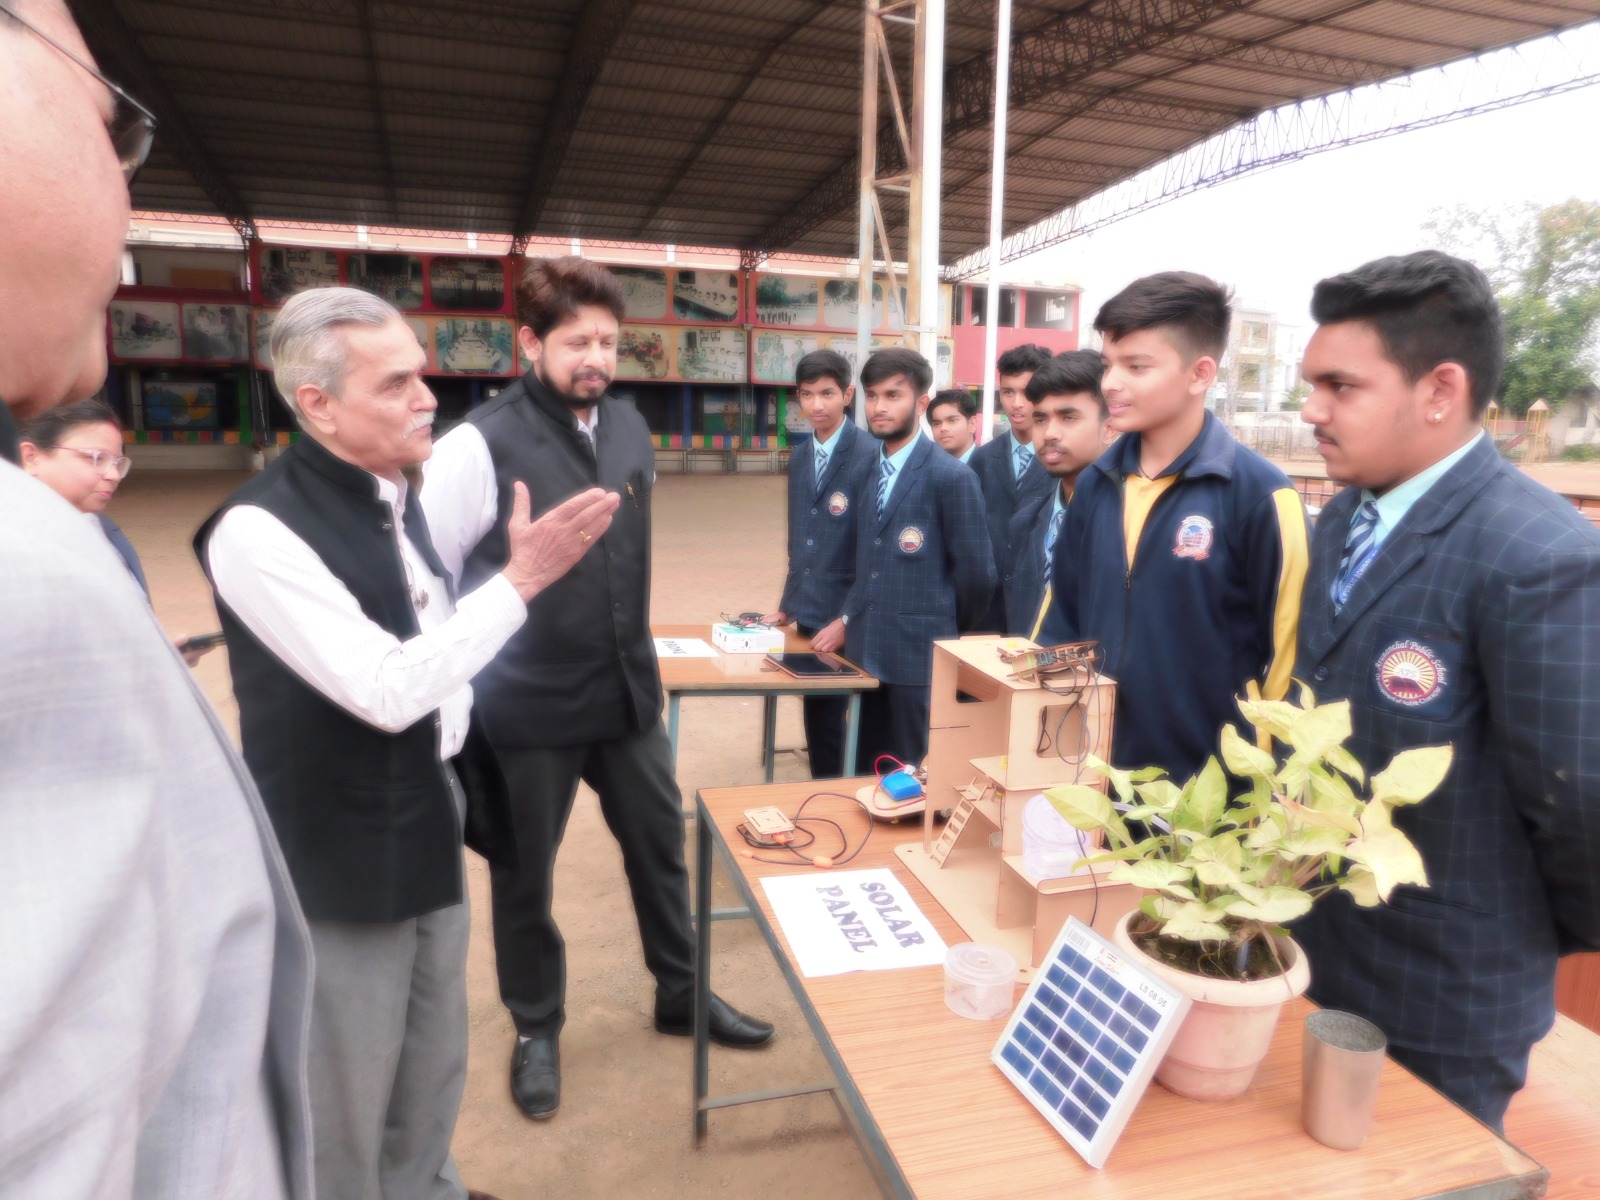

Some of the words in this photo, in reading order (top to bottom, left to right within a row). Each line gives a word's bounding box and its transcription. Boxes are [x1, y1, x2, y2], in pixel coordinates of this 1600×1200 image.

[1410, 641, 1434, 660] Public
[1431, 659, 1447, 685] School
[816, 885, 878, 953] PANEL
[859, 882, 925, 948] SOLAR
